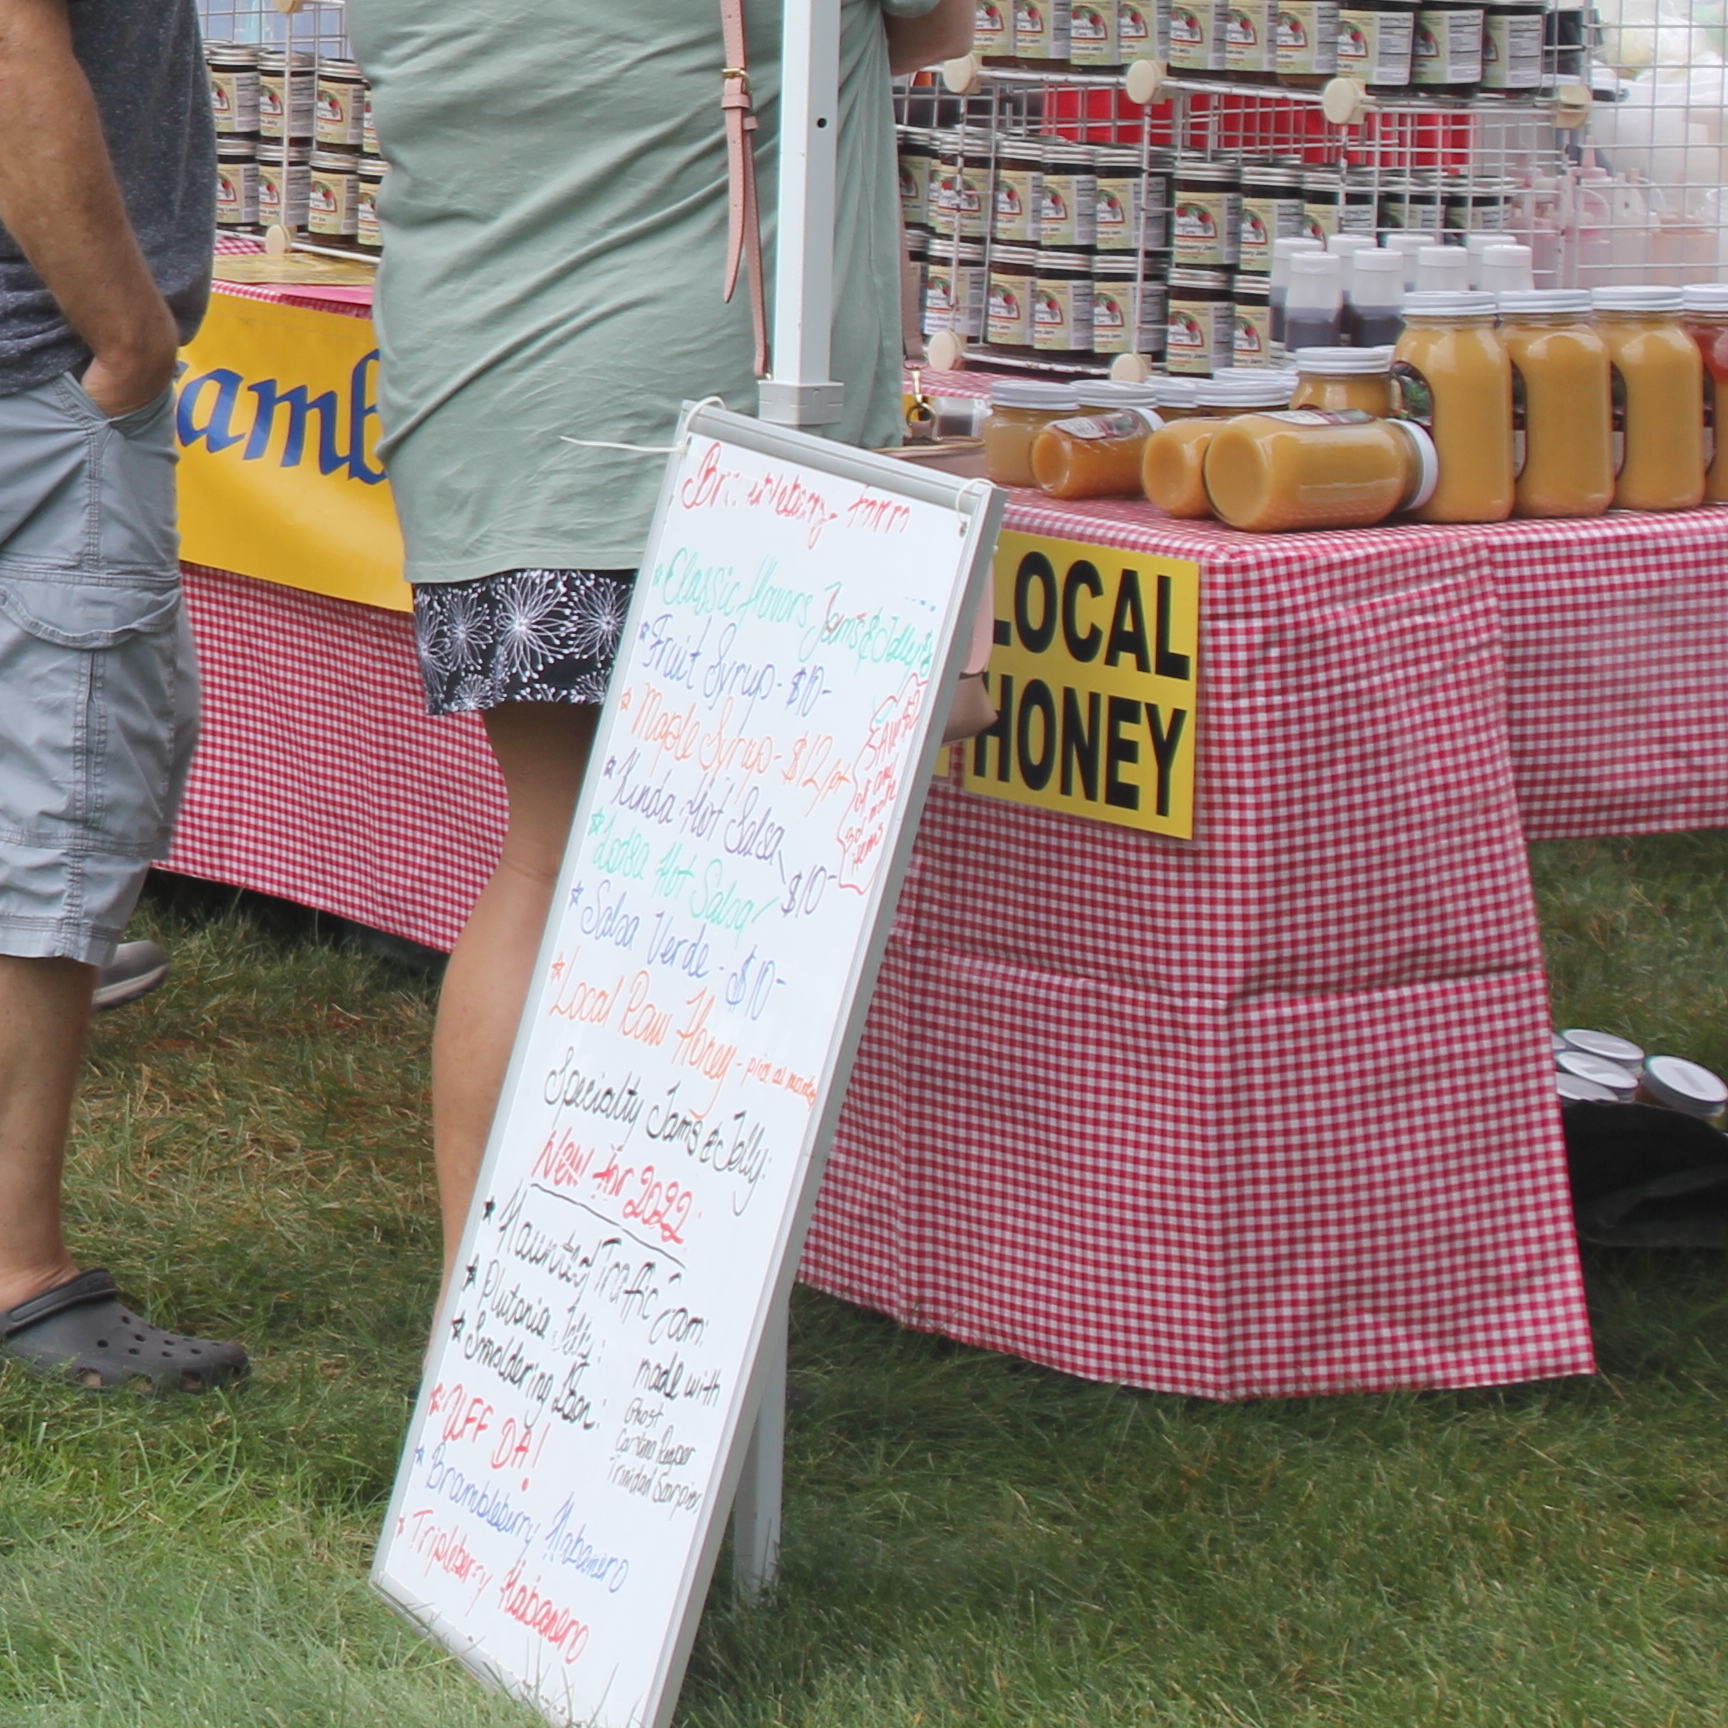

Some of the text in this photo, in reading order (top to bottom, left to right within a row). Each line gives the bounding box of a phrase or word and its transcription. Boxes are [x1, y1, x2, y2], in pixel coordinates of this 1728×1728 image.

[662, 547, 741, 617] Classic
[642, 613, 714, 691] Fruit
[630, 680, 701, 778] Maple
[973, 671, 1189, 818] HONEY
[724, 785, 786, 864] Salsa
[579, 879, 641, 952] Salsa
[646, 910, 710, 979] Verde
[649, 841, 696, 900] Hot
[690, 858, 755, 950] Salsa
[548, 944, 626, 1029] Local
[617, 969, 675, 1048] Raw
[670, 985, 739, 1119] Honey
[544, 1045, 646, 1150] Specialty
[645, 1079, 704, 1157] Jams
[530, 1126, 595, 1188] New
[592, 1142, 635, 1201] for
[591, 1236, 659, 1325] Traffic
[463, 1309, 555, 1430] Smoldering
[623, 1396, 665, 1429] Ghost
[632, 1350, 722, 1409] made with
[425, 1441, 629, 1594] Brambleberry Habanero
[605, 1453, 655, 1497] Trinidad
[409, 1508, 590, 1664] Tripleberry Habanero
